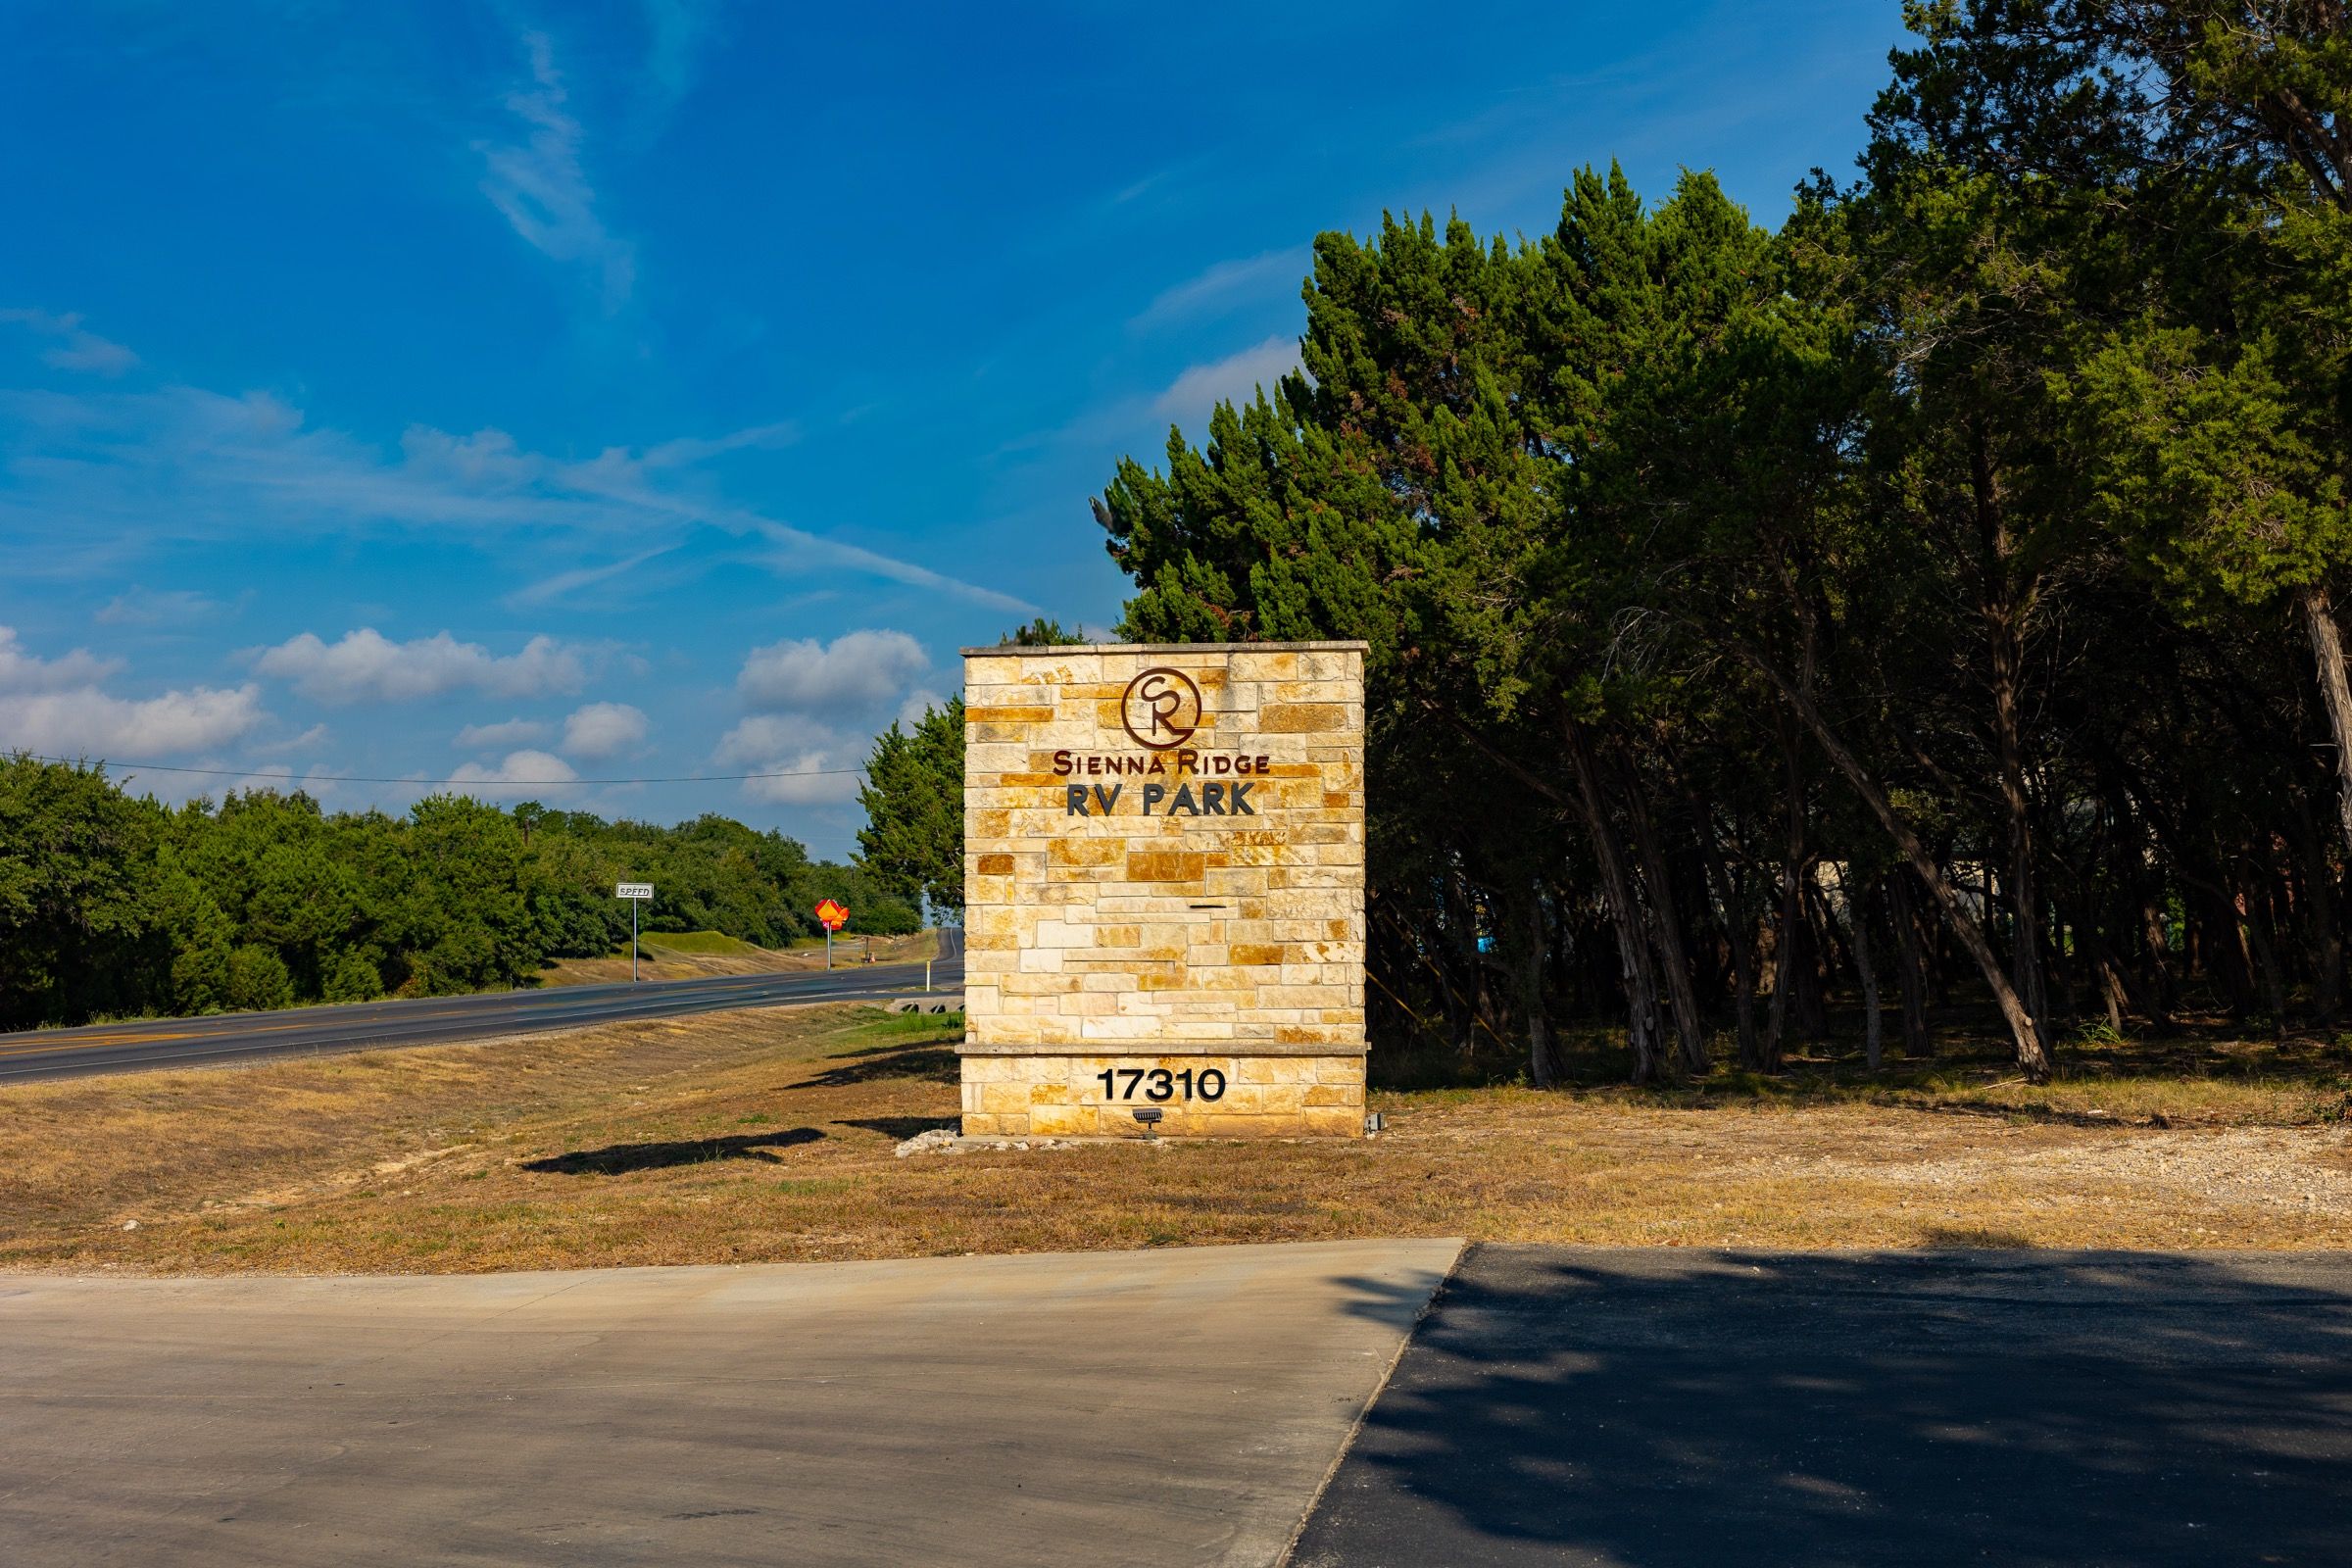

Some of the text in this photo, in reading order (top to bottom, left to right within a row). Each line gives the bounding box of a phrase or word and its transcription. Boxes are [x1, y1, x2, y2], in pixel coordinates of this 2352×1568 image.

[1053, 749, 1271, 776] SIENNA RIDGE
[1066, 783, 1255, 816] RV PARK
[1097, 1068, 1226, 1102] 17310
